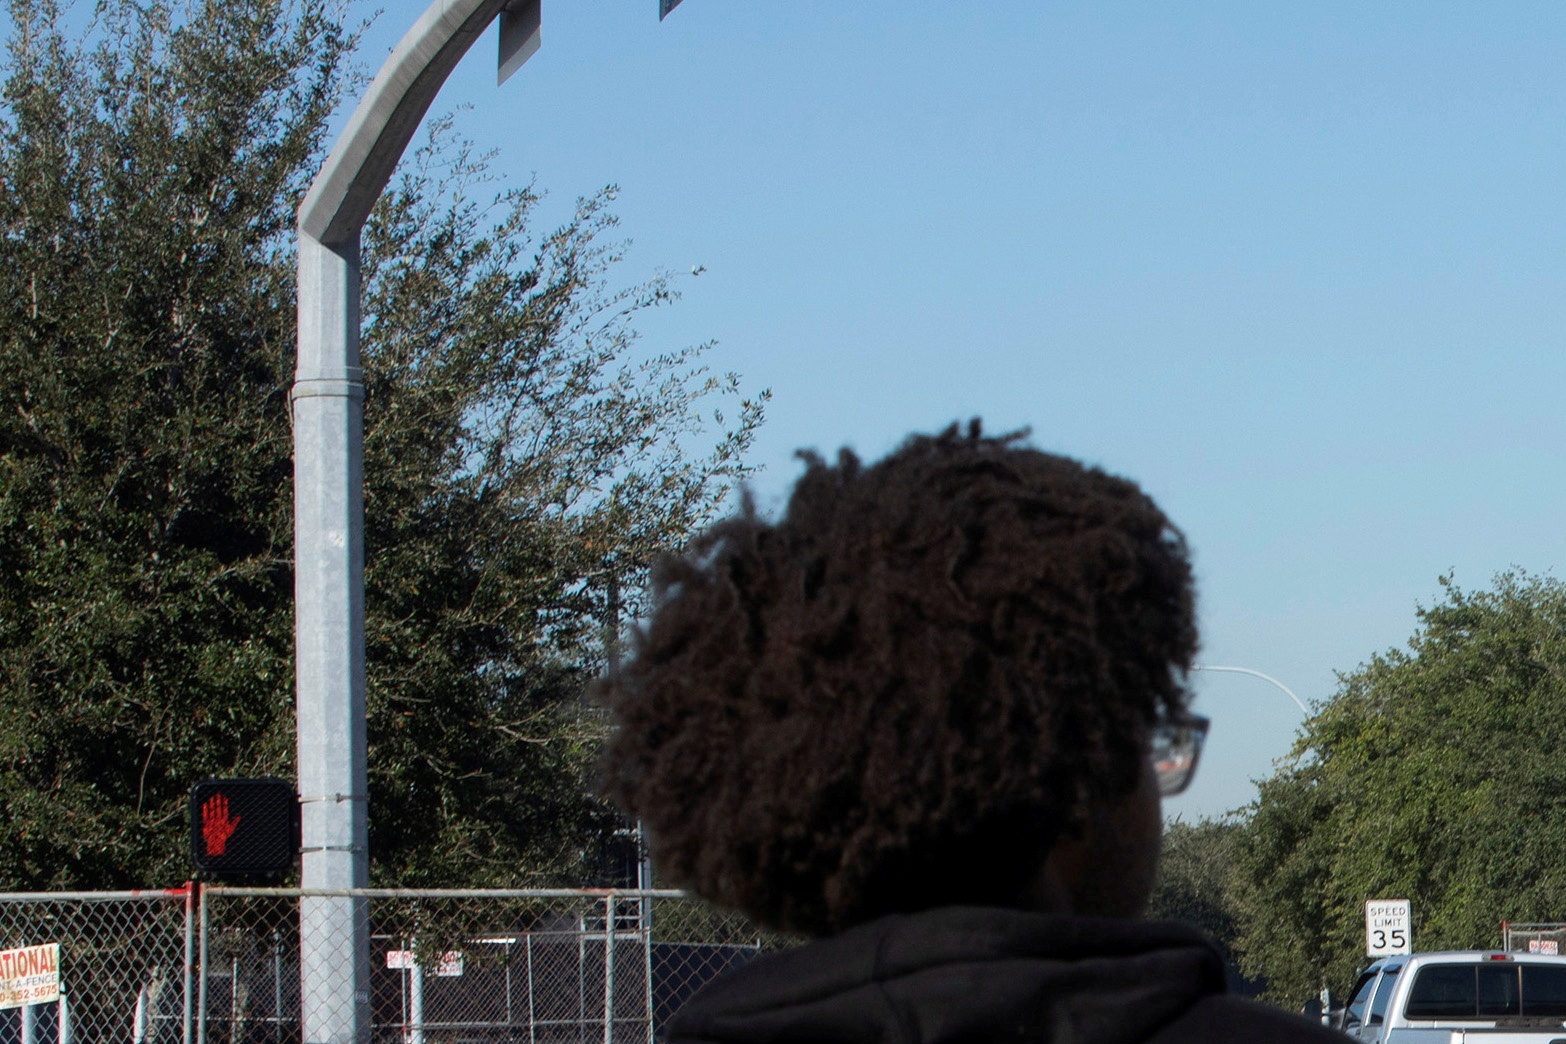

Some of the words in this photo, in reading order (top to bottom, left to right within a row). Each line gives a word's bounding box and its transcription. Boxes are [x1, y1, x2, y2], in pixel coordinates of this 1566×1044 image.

[1370, 906, 1406, 917] SPEED
[1374, 918, 1402, 928] LIMIT
[1372, 929, 1406, 949] 35
